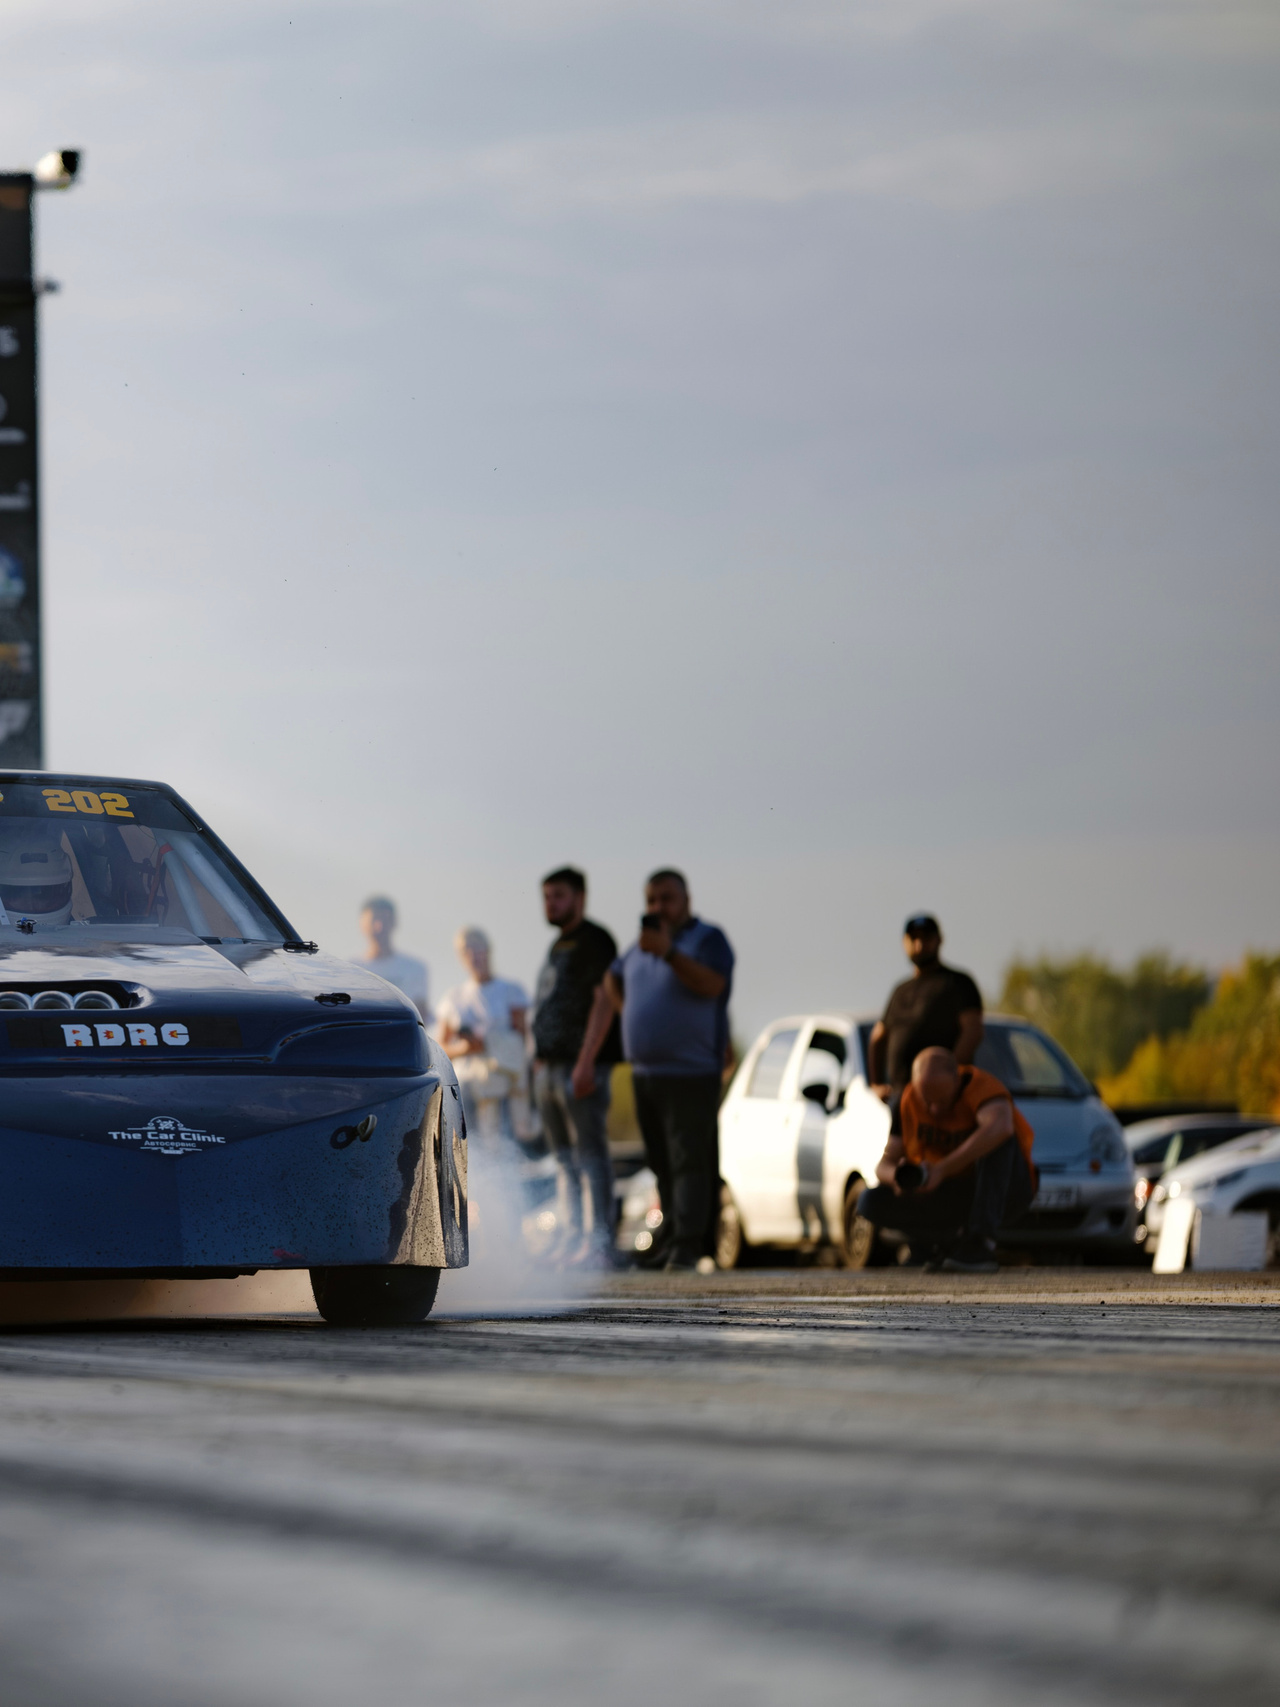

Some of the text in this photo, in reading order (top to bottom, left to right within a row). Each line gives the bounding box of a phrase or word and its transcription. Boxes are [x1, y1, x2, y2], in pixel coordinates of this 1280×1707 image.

[41, 788, 136, 819] 202
[60, 1023, 190, 1046] RDRC
[108, 1131, 226, 1144] The Car Clinic
